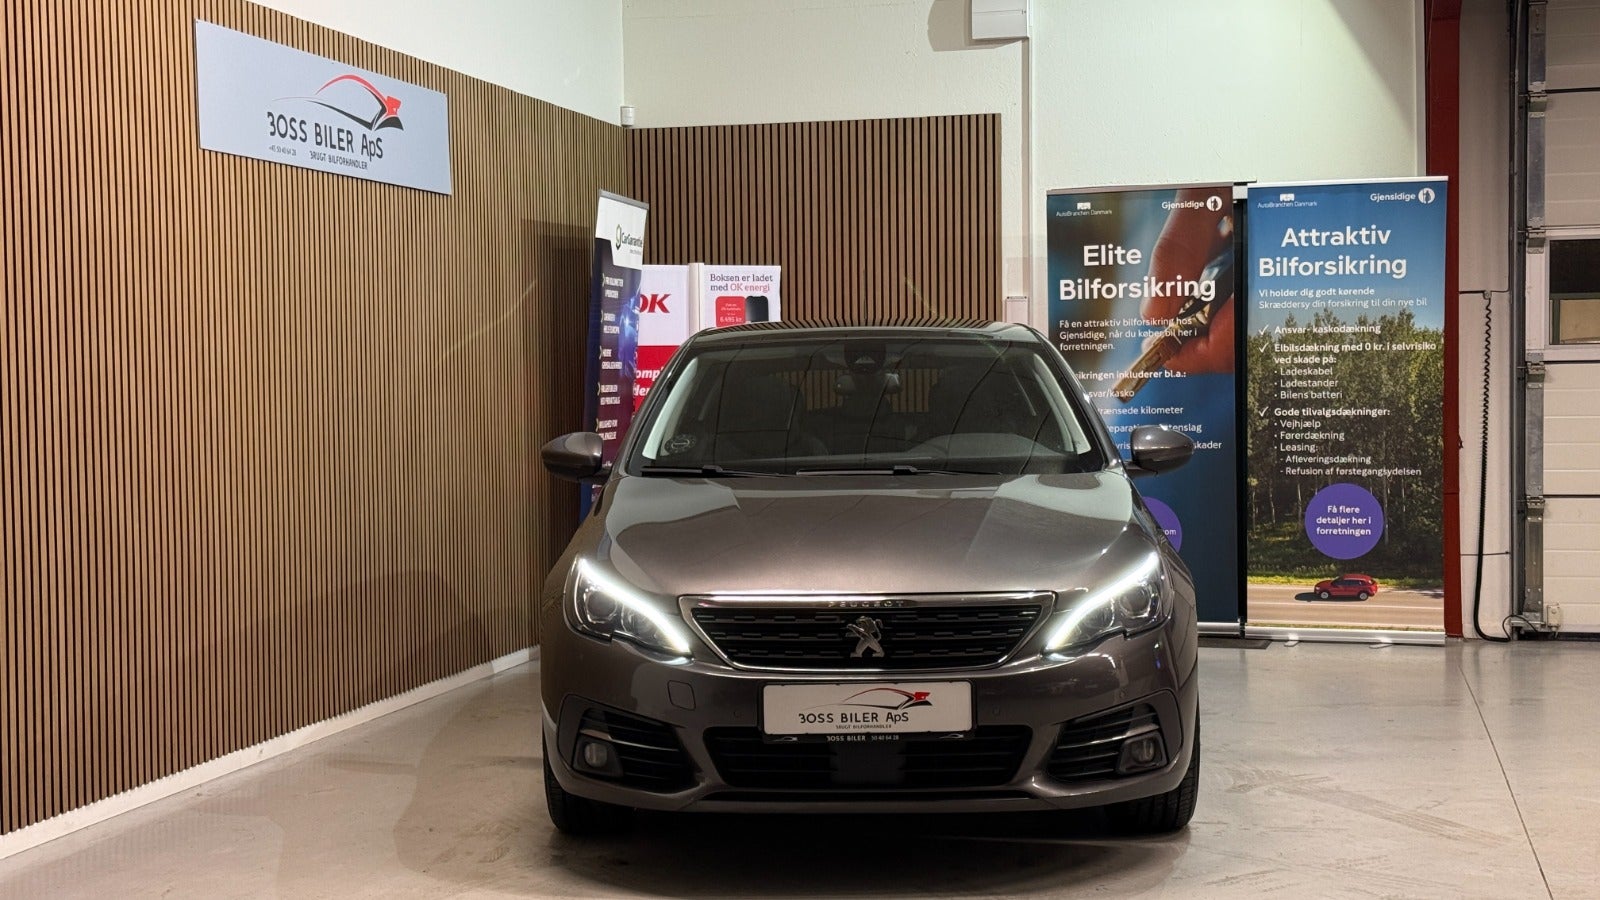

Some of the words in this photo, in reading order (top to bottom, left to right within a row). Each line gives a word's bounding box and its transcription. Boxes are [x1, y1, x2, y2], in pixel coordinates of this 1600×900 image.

[314, 122, 354, 153] BILER
[361, 134, 384, 162] ApS
[328, 154, 368, 170] BILFORHANDLER
[1370, 192, 1416, 203] Gjensidige
[1161, 200, 1205, 210] Gjensidige
[1257, 201, 1294, 209] AutoBranchen
[1056, 209, 1090, 218] AutoBranchen
[1280, 224, 1392, 248] Attraktiv
[1082, 243, 1143, 267] Elite
[1258, 254, 1408, 280] Bilforsikring
[710, 274, 740, 282] Boksen
[752, 274, 774, 282] ladet
[710, 284, 728, 292] med
[730, 283, 744, 292] OK
[744, 284, 770, 293] energi
[1059, 275, 1216, 302] Bilforsikring
[1258, 288, 1268, 298] Vi
[1270, 288, 1298, 297] holder
[1300, 288, 1314, 298] dig
[1315, 288, 1336, 298] godt
[1338, 287, 1375, 296] kørende
[1258, 300, 1310, 310] Skræddersy
[1312, 300, 1326, 308] din
[1328, 299, 1369, 309] forsikring
[1371, 299, 1380, 307] til
[1382, 298, 1396, 307] din
[1398, 300, 1414, 309] nye
[1416, 298, 1428, 306] bil
[1059, 319, 1070, 328] Få
[1072, 320, 1082, 328] en
[1083, 318, 1121, 328] attraktiv
[1122, 317, 1174, 328] bilforsikring
[1176, 317, 1192, 326] hos
[1059, 330, 1108, 342] Gjensidige,
[1108, 329, 1123, 338] når
[1124, 330, 1136, 338] du
[1138, 330, 1164, 338] køber
[1165, 328, 1176, 337] bil
[1177, 328, 1192, 338] her
[1312, 324, 1382, 335] kaskodækning
[1059, 342, 1116, 353] forretningen.
[1274, 343, 1340, 354] Elbilsdækning
[1341, 343, 1363, 352] med
[1364, 343, 1371, 351] 0
[1372, 343, 1385, 352] kr.
[1392, 342, 1437, 351] selvrisiko
[1274, 356, 1293, 364] ved
[1294, 356, 1320, 364] skade
[1322, 355, 1337, 366] på:
[1076, 372, 1115, 382] sikringen
[1116, 370, 1163, 380] inkluderer
[1164, 370, 1187, 378] bl.a.:
[1280, 368, 1333, 376] Ladeskabel
[1280, 380, 1339, 388] Ladestander
[1088, 388, 1135, 398] svar/kasko
[1280, 392, 1309, 400] Bilens
[1310, 392, 1343, 400] batteri
[1098, 406, 1139, 416] rænsede
[1140, 406, 1184, 415] kilometer
[1274, 408, 1300, 416] Gode
[1302, 408, 1391, 418] tilvalgsdækninger:
[1280, 420, 1322, 429] Vejhjælp
[1280, 431, 1345, 442] Førerdækning
[1280, 443, 1319, 453] Leasing:
[1285, 454, 1372, 465] Afleveringsdækning
[1285, 467, 1324, 476] Refusion
[1325, 466, 1334, 476] af
[1336, 466, 1422, 478] førstegangsydelsen
[1327, 505, 1338, 514] Få
[1339, 505, 1360, 514] flere
[1316, 516, 1350, 526] detaljer
[1352, 516, 1366, 524] her
[1316, 527, 1372, 537] forretningen
[828, 600, 904, 608] PEUGEOT
[840, 712, 879, 723] BILER
[886, 712, 909, 724] ApS
